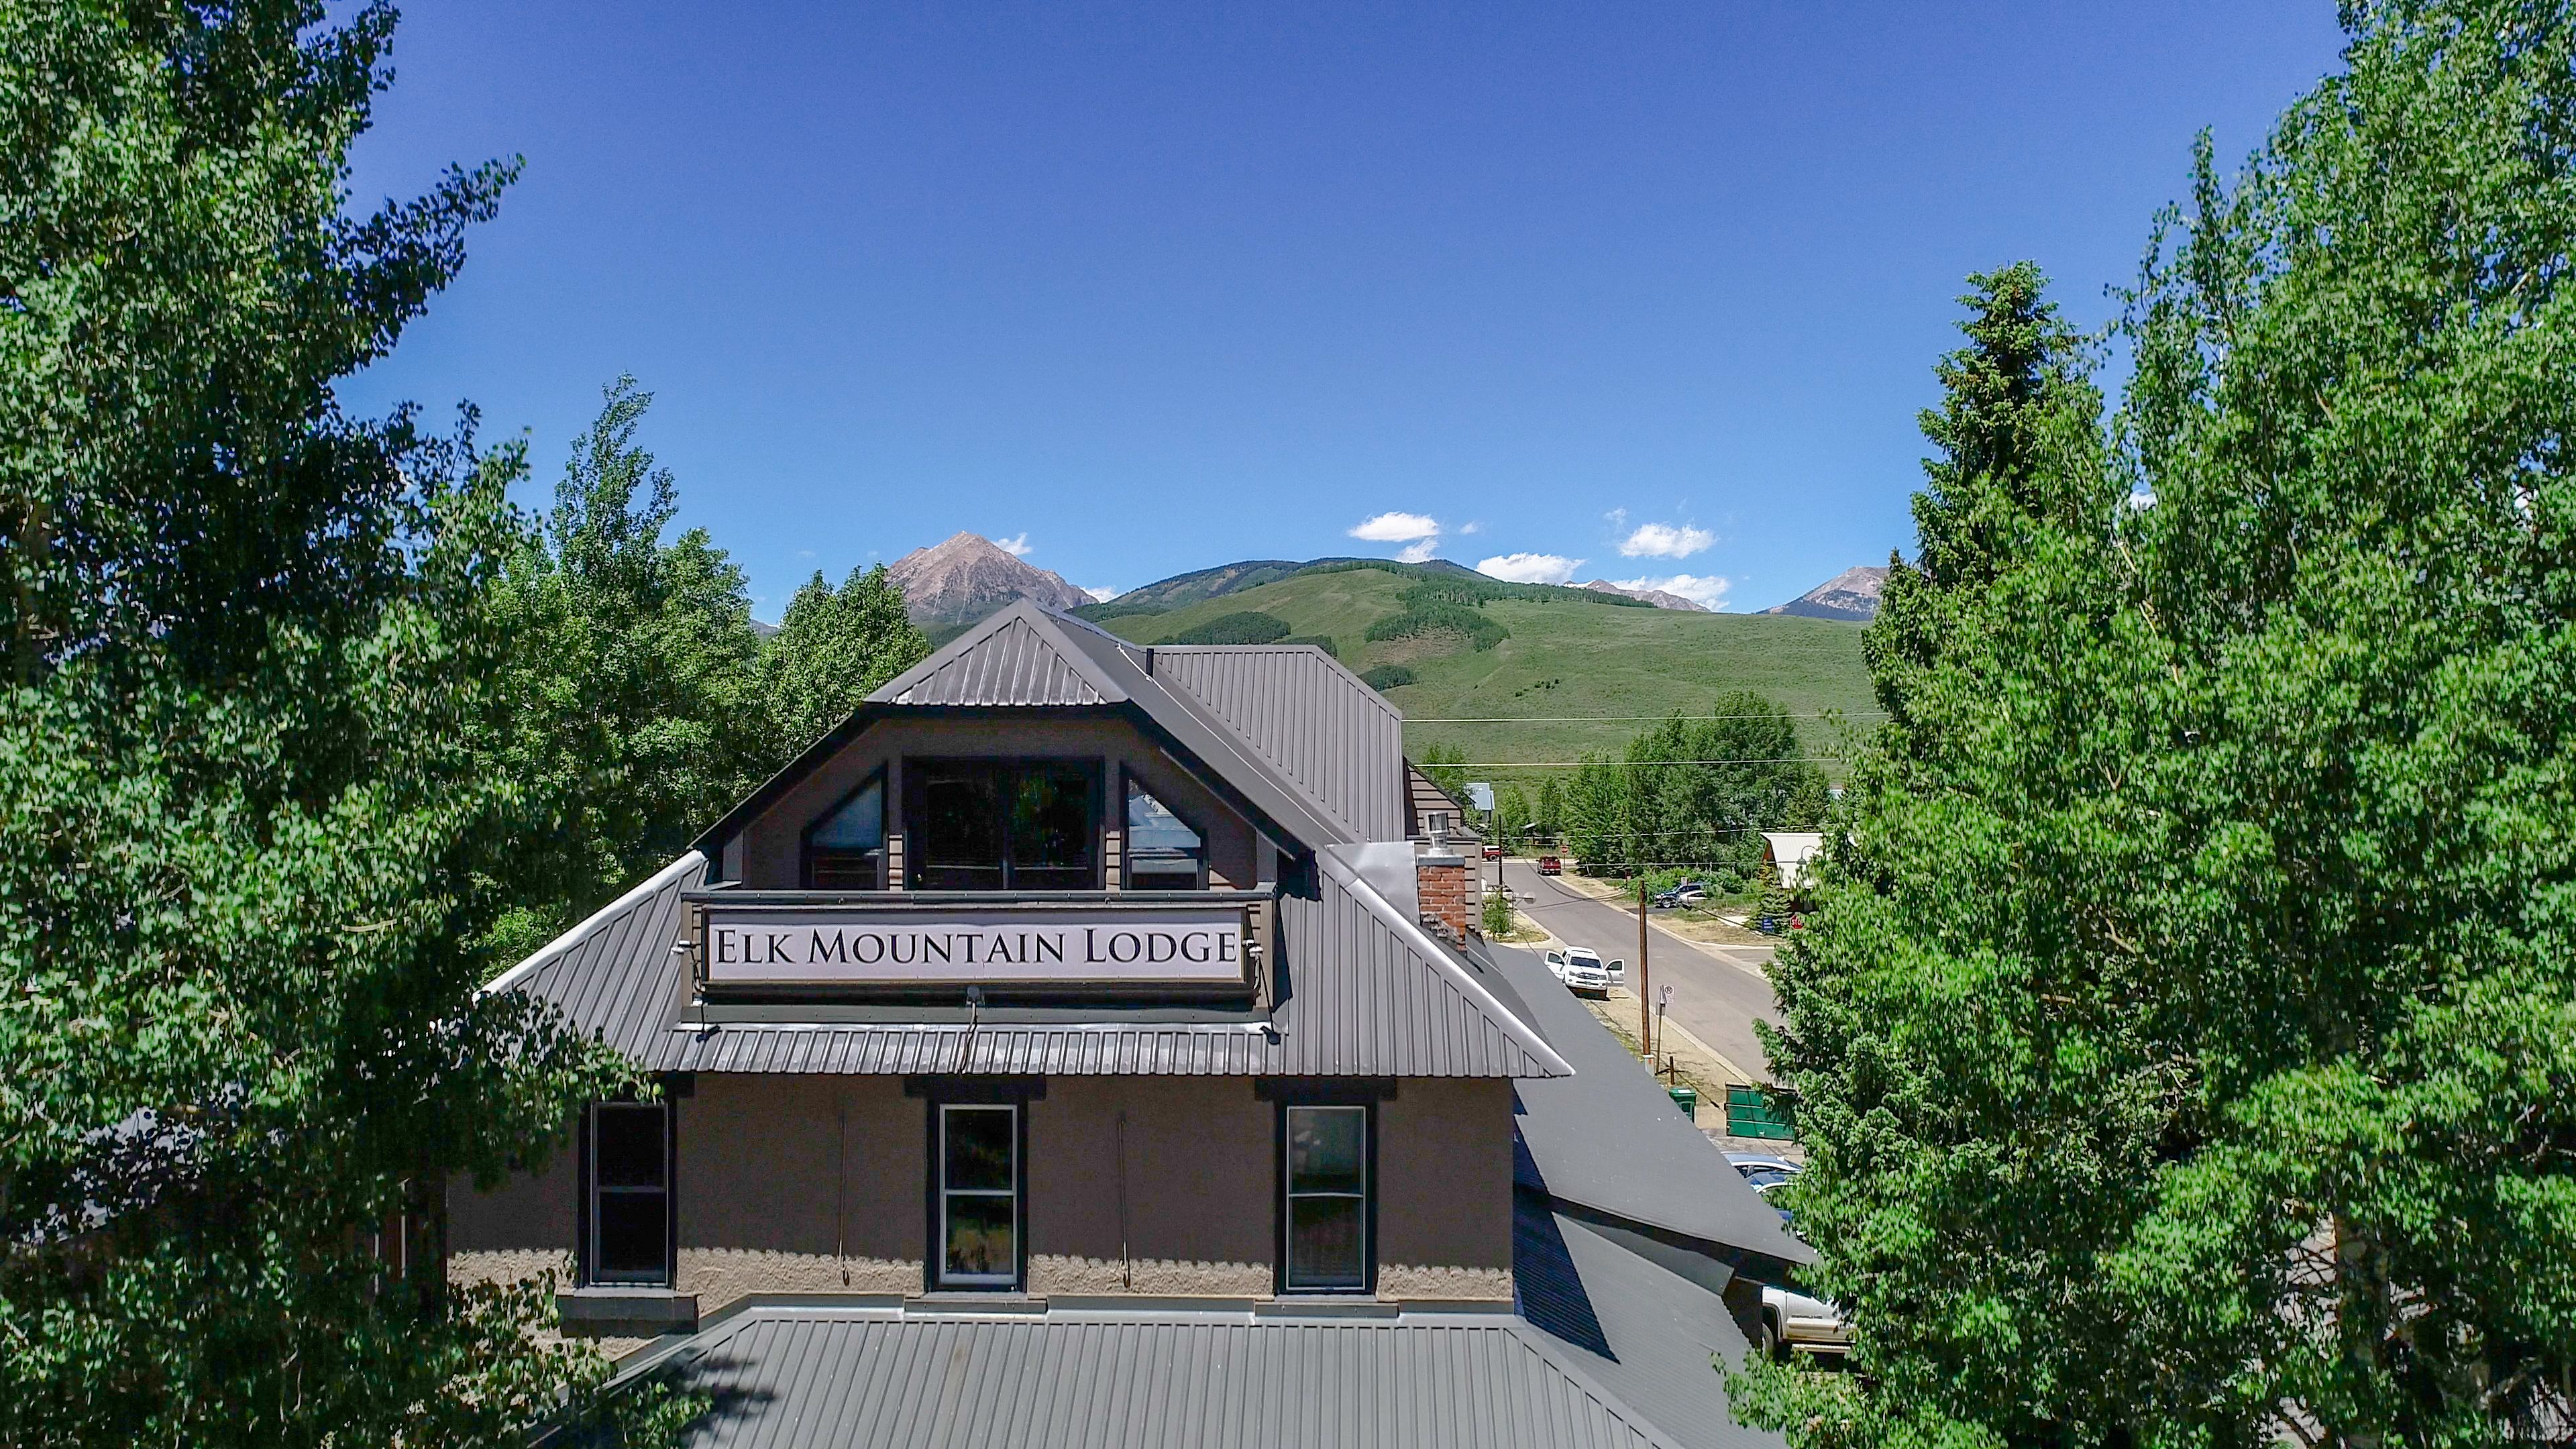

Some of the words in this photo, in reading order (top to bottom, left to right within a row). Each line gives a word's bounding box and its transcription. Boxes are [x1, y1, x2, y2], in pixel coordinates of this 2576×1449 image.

[1791, 918, 1803, 926] STO
[716, 928, 796, 964] ELK
[808, 928, 1064, 964] MOUNTAIN
[1085, 928, 1238, 963] LODGE
